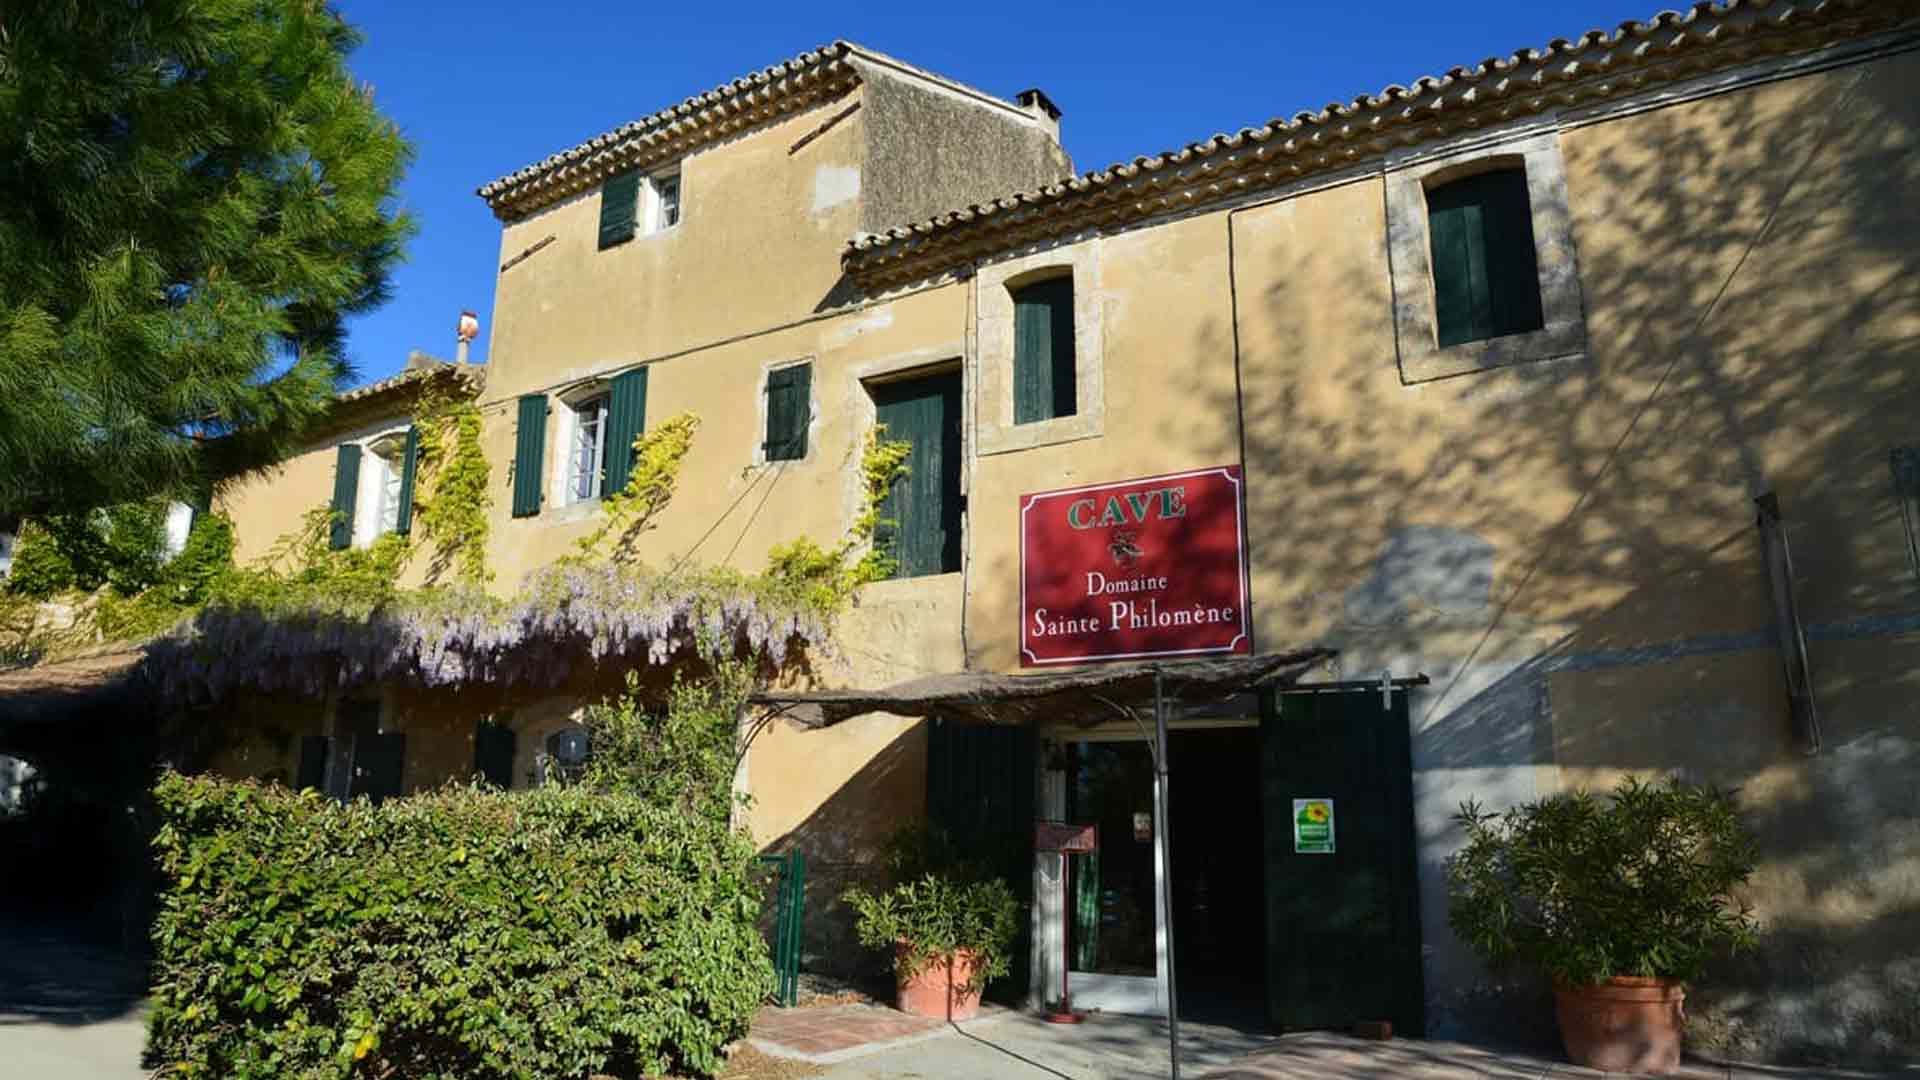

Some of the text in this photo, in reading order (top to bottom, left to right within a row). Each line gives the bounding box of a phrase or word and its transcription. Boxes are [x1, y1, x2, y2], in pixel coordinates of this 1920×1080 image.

[1068, 488, 1186, 529] CAVE
[1087, 572, 1168, 596] Domaine
[1032, 598, 1233, 637] Sainte Philomène
